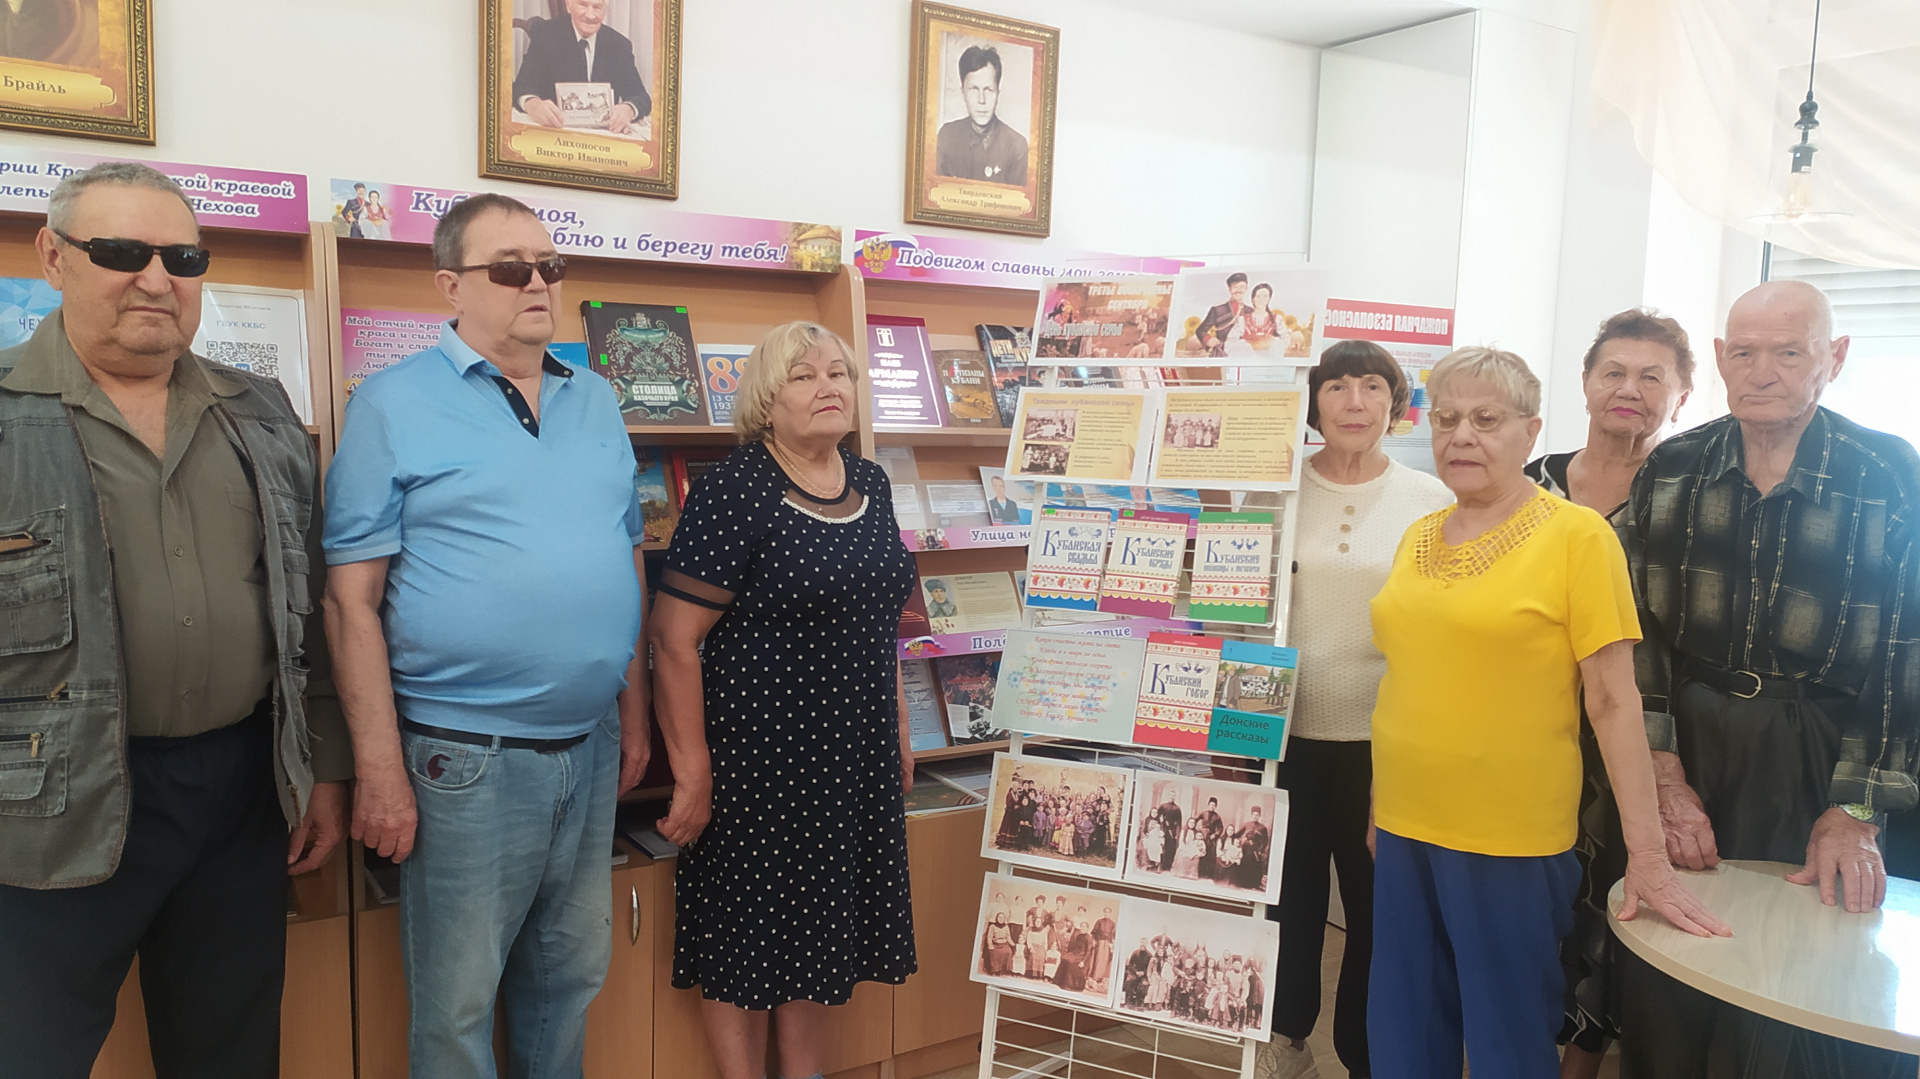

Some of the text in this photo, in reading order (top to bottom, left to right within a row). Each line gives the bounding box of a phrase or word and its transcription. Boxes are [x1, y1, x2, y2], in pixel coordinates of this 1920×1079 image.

[3, 75, 66, 94] Брайль
[554, 137, 611, 153] Лихоносов
[536, 146, 628, 167] Виктор Иванович
[214, 181, 294, 197] краевой
[549, 226, 787, 262] блю и берегу тебя!
[898, 249, 985, 271] Подвигом
[19, 318, 41, 331] ЧЕ
[241, 321, 266, 329] ККБС
[347, 316, 440, 331] Мой отчий кра
[359, 330, 396, 338] краса
[354, 339, 393, 349] Богат
[632, 384, 678, 395] СТОЛИЦА
[971, 530, 1015, 542] Улица
[1220, 714, 1270, 730] Донские
[1216, 729, 1269, 744] рассказы
